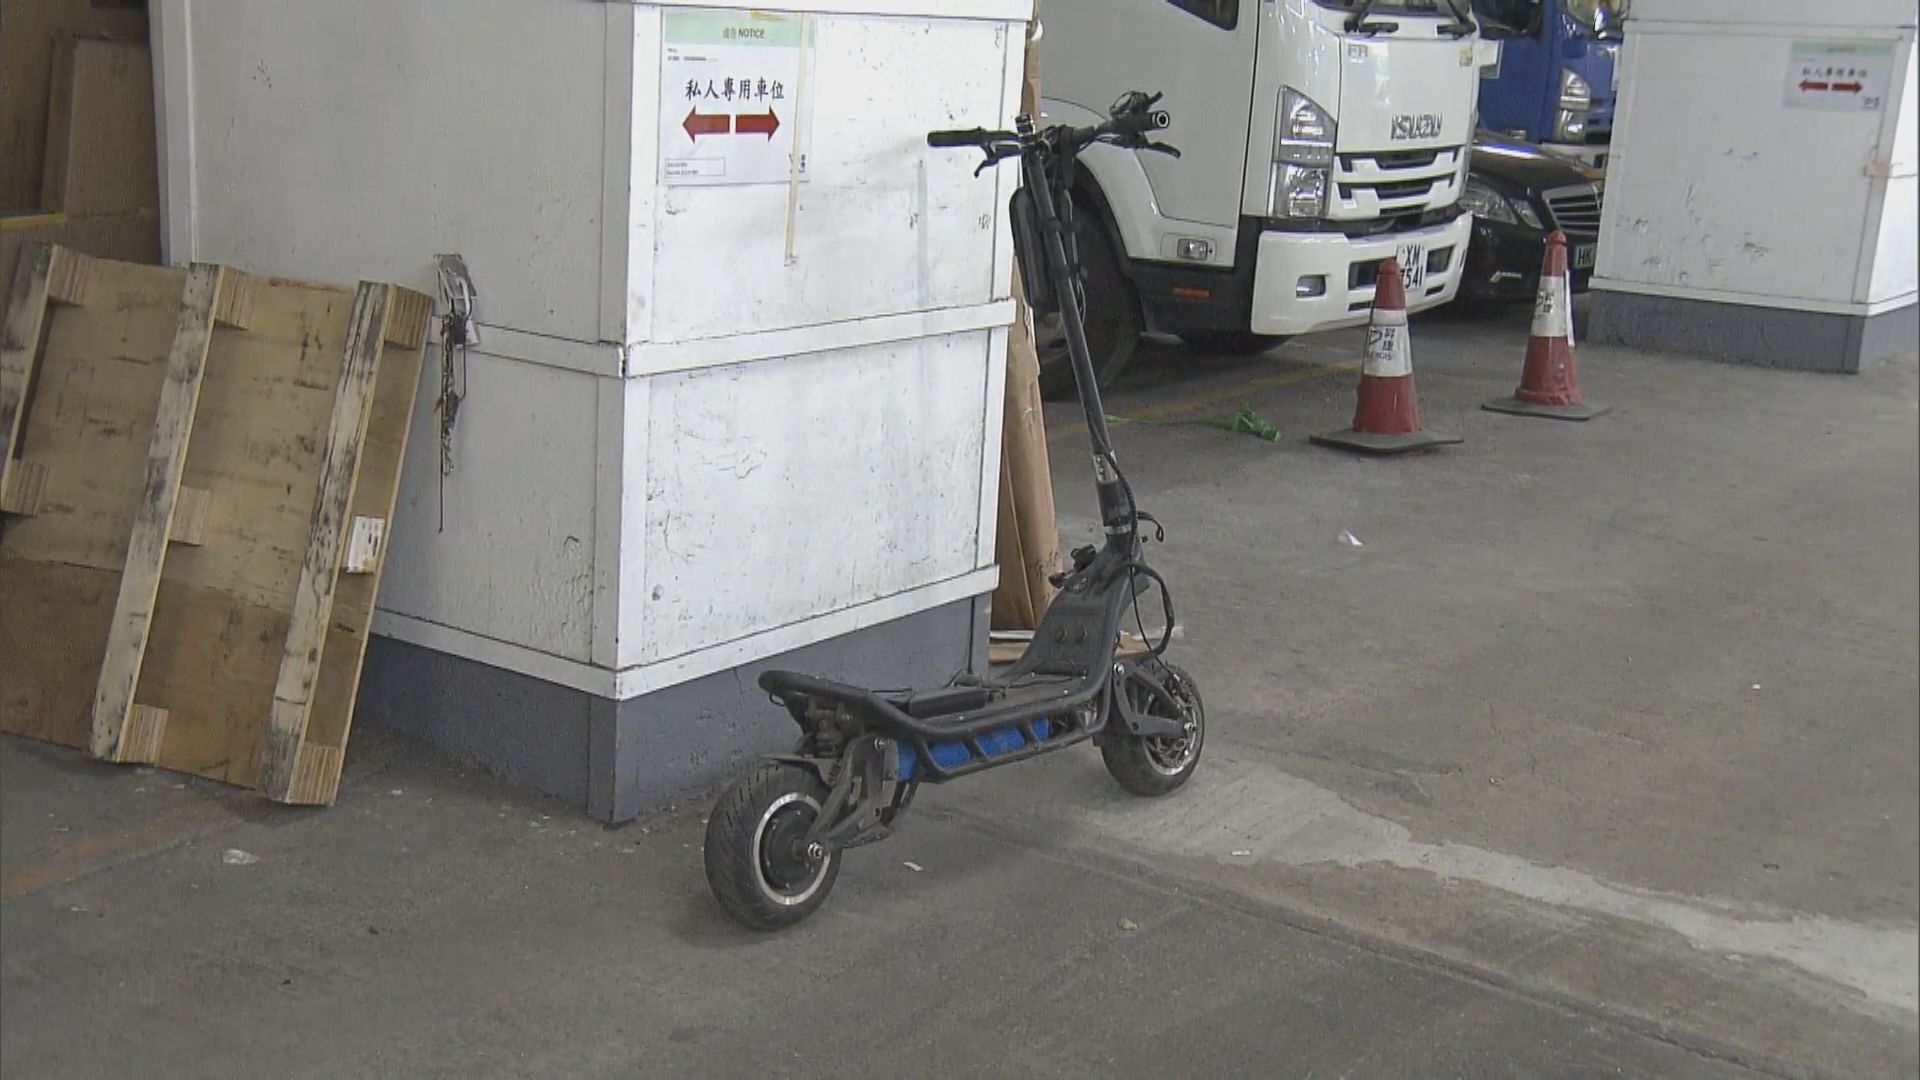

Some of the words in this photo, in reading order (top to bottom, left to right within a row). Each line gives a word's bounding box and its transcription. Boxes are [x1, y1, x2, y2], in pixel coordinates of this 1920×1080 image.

[738, 27, 765, 39] NOTICE
[685, 76, 785, 102] 私人專用車位
[1391, 113, 1442, 140] ISUZU
